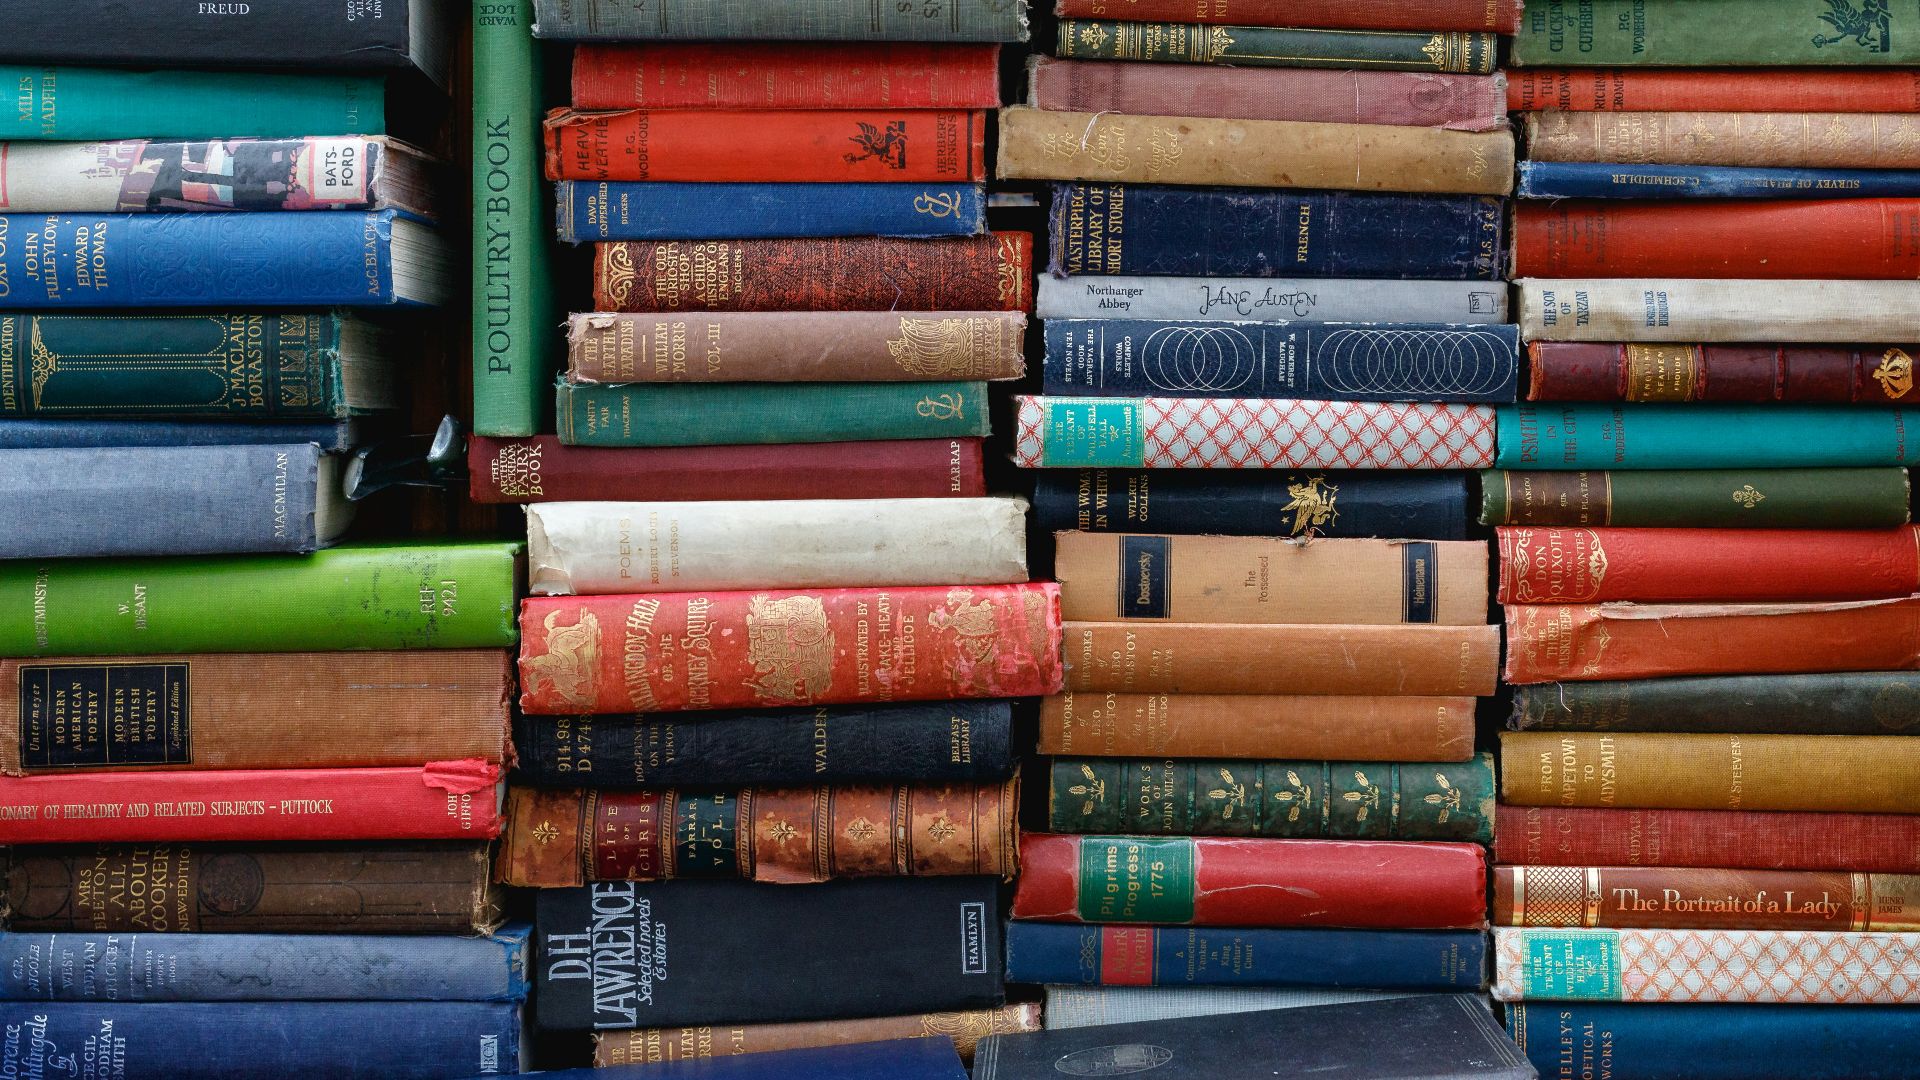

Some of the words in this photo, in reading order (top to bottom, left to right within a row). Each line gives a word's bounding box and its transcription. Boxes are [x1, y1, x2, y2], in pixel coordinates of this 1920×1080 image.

[199, 2, 250, 14] FREUD
[479, 4, 517, 14] LOCK
[479, 15, 517, 27] WARD
[1532, 11, 1546, 34] THE
[1618, 11, 1631, 32] P.G.
[19, 76, 33, 122] MILES
[1541, 75, 1553, 97] THE
[625, 131, 637, 155] P.G.
[936, 112, 948, 175] HERBERT
[947, 112, 959, 176] JENKINS
[1465, 145, 1488, 181] Foyle
[325, 146, 338, 187] BATS-
[341, 146, 355, 187] FORD
[1611, 174, 1686, 186] SCHMEIDLER
[1816, 179, 1860, 190] SURVEY
[588, 196, 598, 225] DAVID
[599, 182, 609, 238] COPPERFIELD
[621, 192, 629, 225] DICKENS
[1089, 186, 1105, 206] OF
[1109, 184, 1124, 235] STORIES
[1087, 210, 1104, 272] LIBRARY
[1297, 204, 1312, 263] FRENCH
[26, 232, 39, 281] JOHN
[44, 214, 61, 300] FULLEYLOVE
[75, 226, 91, 288] EDWARD
[93, 221, 110, 292] THOMAS
[655, 245, 667, 273] OLD
[680, 252, 691, 292] SHOP
[692, 244, 706, 290] CHILD'S
[718, 243, 729, 302] ENGLAND
[734, 249, 743, 293] DICKENS
[1106, 237, 1122, 275] SHORT
[655, 275, 667, 300] THE
[694, 292, 705, 303] A
[706, 258, 718, 307] HISTORY
[1086, 285, 1144, 299] Northanger
[1542, 290, 1556, 307] SON
[1098, 297, 1132, 314] Abbey
[1542, 308, 1557, 327] THE
[1560, 302, 1572, 315] OF
[1575, 290, 1590, 327] TARZAN
[584, 339, 599, 362] THE
[620, 318, 635, 378] PARADISE
[655, 321, 669, 375] WILLIAM
[671, 319, 687, 374] MORRIS
[1065, 331, 1073, 348] TEN
[1078, 345, 1086, 370] MOOD
[1087, 328, 1095, 346] THE
[1115, 341, 1123, 374] WORKS
[1124, 335, 1132, 379] COMPLETE
[2, 316, 17, 411] IDENTIFICATION
[247, 314, 265, 408] BORASTON
[1065, 350, 1073, 383] NOVELS
[1087, 347, 1095, 386] VAGRANT
[1279, 341, 1287, 382] MAUGHAM
[1288, 344, 1296, 389] SOMERSET
[1657, 351, 1666, 392] SEAMEN
[586, 399, 596, 438] VANITY
[600, 406, 610, 429] FAIR
[621, 395, 632, 439] THACKERAY
[1519, 407, 1538, 464] PSMITH
[490, 457, 500, 484] THE
[499, 446, 510, 495] ARTHUR
[508, 442, 518, 497] RACKHAM
[516, 441, 531, 497] FAIRY
[529, 443, 544, 497] BOOK
[950, 440, 961, 492] HARRAP
[273, 451, 288, 539] MACMILLAN
[1128, 477, 1138, 519] WILKIE
[1138, 474, 1150, 522] COLLINS
[1078, 509, 1091, 531] THE
[1096, 514, 1108, 529] IN
[619, 517, 632, 580] POEMS
[650, 542, 660, 585] ROBERT
[671, 518, 681, 579] STEVENSON
[1536, 545, 1547, 581] DON
[1550, 530, 1564, 596] QUIXOTE
[1565, 556, 1573, 578] VOL.
[1574, 532, 1585, 596] CERVANTES
[1136, 551, 1153, 605] Dostoevsky
[1244, 570, 1257, 588] The
[1257, 555, 1269, 604] Possessed
[1412, 558, 1425, 605] Heinemann
[117, 600, 130, 616] W.
[134, 583, 147, 631] BESANT
[857, 600, 869, 617] BY
[660, 632, 674, 659] THE
[857, 619, 871, 697] ILLUSTRATED
[900, 614, 915, 686] JELLICOE
[1546, 618, 1559, 658] THREE
[1559, 606, 1573, 670] MUSKETEERS
[114, 687, 125, 743] MODERN
[131, 687, 141, 743] BRITISH
[146, 689, 157, 742] POETRY
[172, 680, 181, 708] Edition
[1147, 695, 1156, 722] THEN
[30, 683, 42, 752] Untermeyer
[56, 689, 66, 744] MODERN
[73, 681, 83, 752] AMERICAN
[88, 690, 98, 743] POETRY
[557, 717, 572, 773] 914.98
[649, 750, 659, 768] ON
[663, 723, 675, 764] YUKON
[814, 707, 827, 774] WALDEN
[951, 716, 962, 764] BELFAST
[961, 719, 971, 764] LIBRARY
[577, 758, 593, 773] D
[1541, 750, 1553, 793] FROM
[1584, 764, 1594, 784] TO
[44, 803, 60, 820] OF
[64, 802, 124, 819] HERALDRY
[126, 802, 151, 818] AND
[153, 800, 207, 817] RELATED
[210, 799, 265, 816] SUBJECTS
[281, 798, 334, 816] PUTTOCK
[1140, 764, 1151, 818] WORKS
[1153, 784, 1161, 799] OF
[606, 804, 618, 862] LIFE
[624, 823, 631, 841] OF
[639, 790, 652, 871] CHRIST
[1163, 802, 1173, 830] JOHN
[712, 814, 724, 867] VOL.
[79, 868, 92, 908] MRS
[111, 863, 127, 908] ALL
[130, 846, 150, 927] ABOUT
[1101, 845, 1120, 916] Pilgrims
[1122, 844, 1141, 917] Progress
[1150, 861, 1166, 900] 1775
[1877, 896, 1905, 905] HENRY
[636, 896, 652, 943] novels
[1613, 888, 1658, 912] The
[1662, 888, 1742, 913] Portrait
[1743, 890, 1767, 914] of
[1767, 900, 1781, 914] a
[1783, 890, 1842, 920] Lady
[1878, 905, 1903, 914] JAMES
[548, 926, 592, 981] D.H.
[592, 881, 637, 1029] LAWRENCE
[653, 920, 668, 966] stories
[968, 910, 979, 967] HAMLYN
[28, 943, 41, 993] NICOLE
[62, 948, 74, 991] WEST
[105, 935, 120, 1001] CRICKET
[637, 944, 653, 1006] Selected
[1533, 956, 1542, 978] THE
[1543, 944, 1554, 990] TENANT
[1555, 959, 1564, 976] OF
[1564, 940, 1575, 994] WILDFELL
[1575, 954, 1586, 983] HALL
[1599, 972, 1611, 994] Anne
[1601, 1031, 1613, 1080] WORKS
